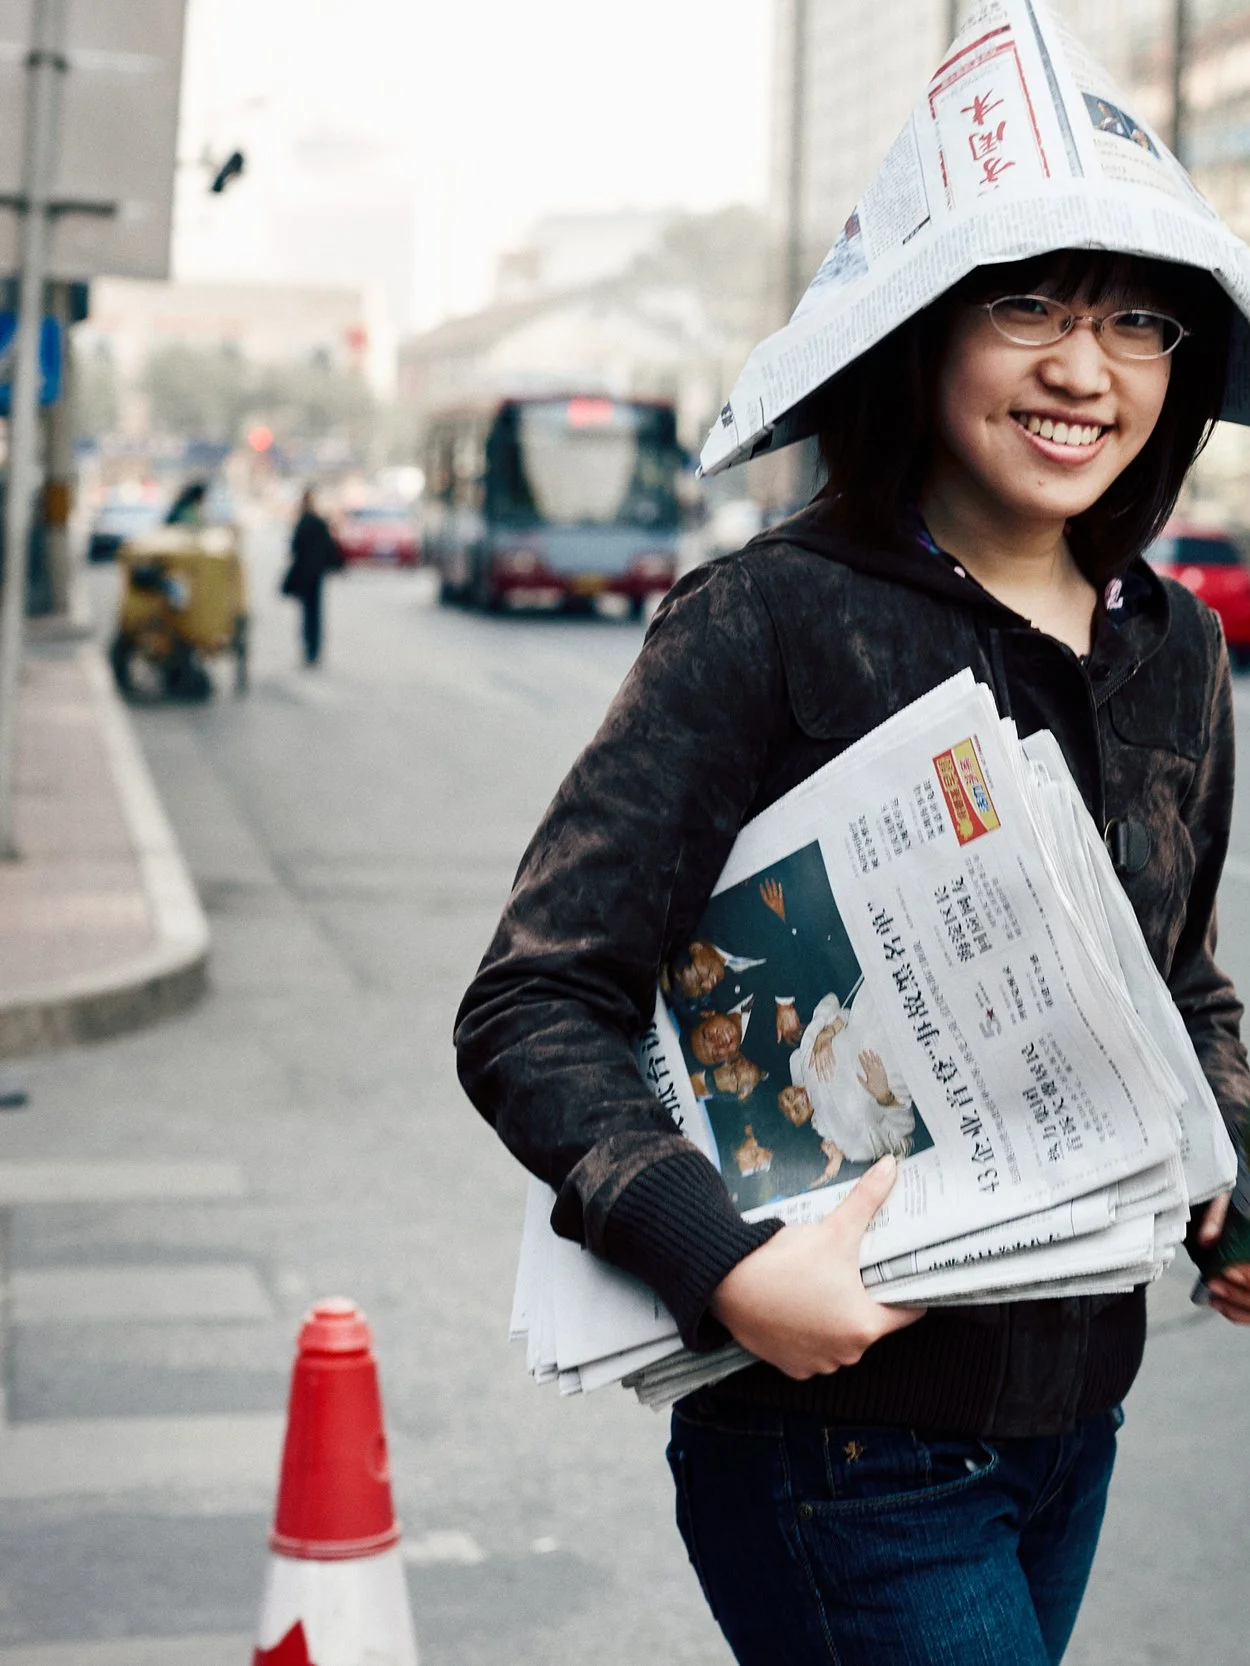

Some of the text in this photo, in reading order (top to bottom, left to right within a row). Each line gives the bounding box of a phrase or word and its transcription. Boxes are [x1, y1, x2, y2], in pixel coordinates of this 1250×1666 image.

[959, 88, 1016, 197] 方周末
[933, 885, 975, 964] 海淀区长
[949, 875, 992, 954] 回应网友
[639, 1022, 684, 1130] 抵台访
[1021, 1086, 1061, 1163] 热力集团
